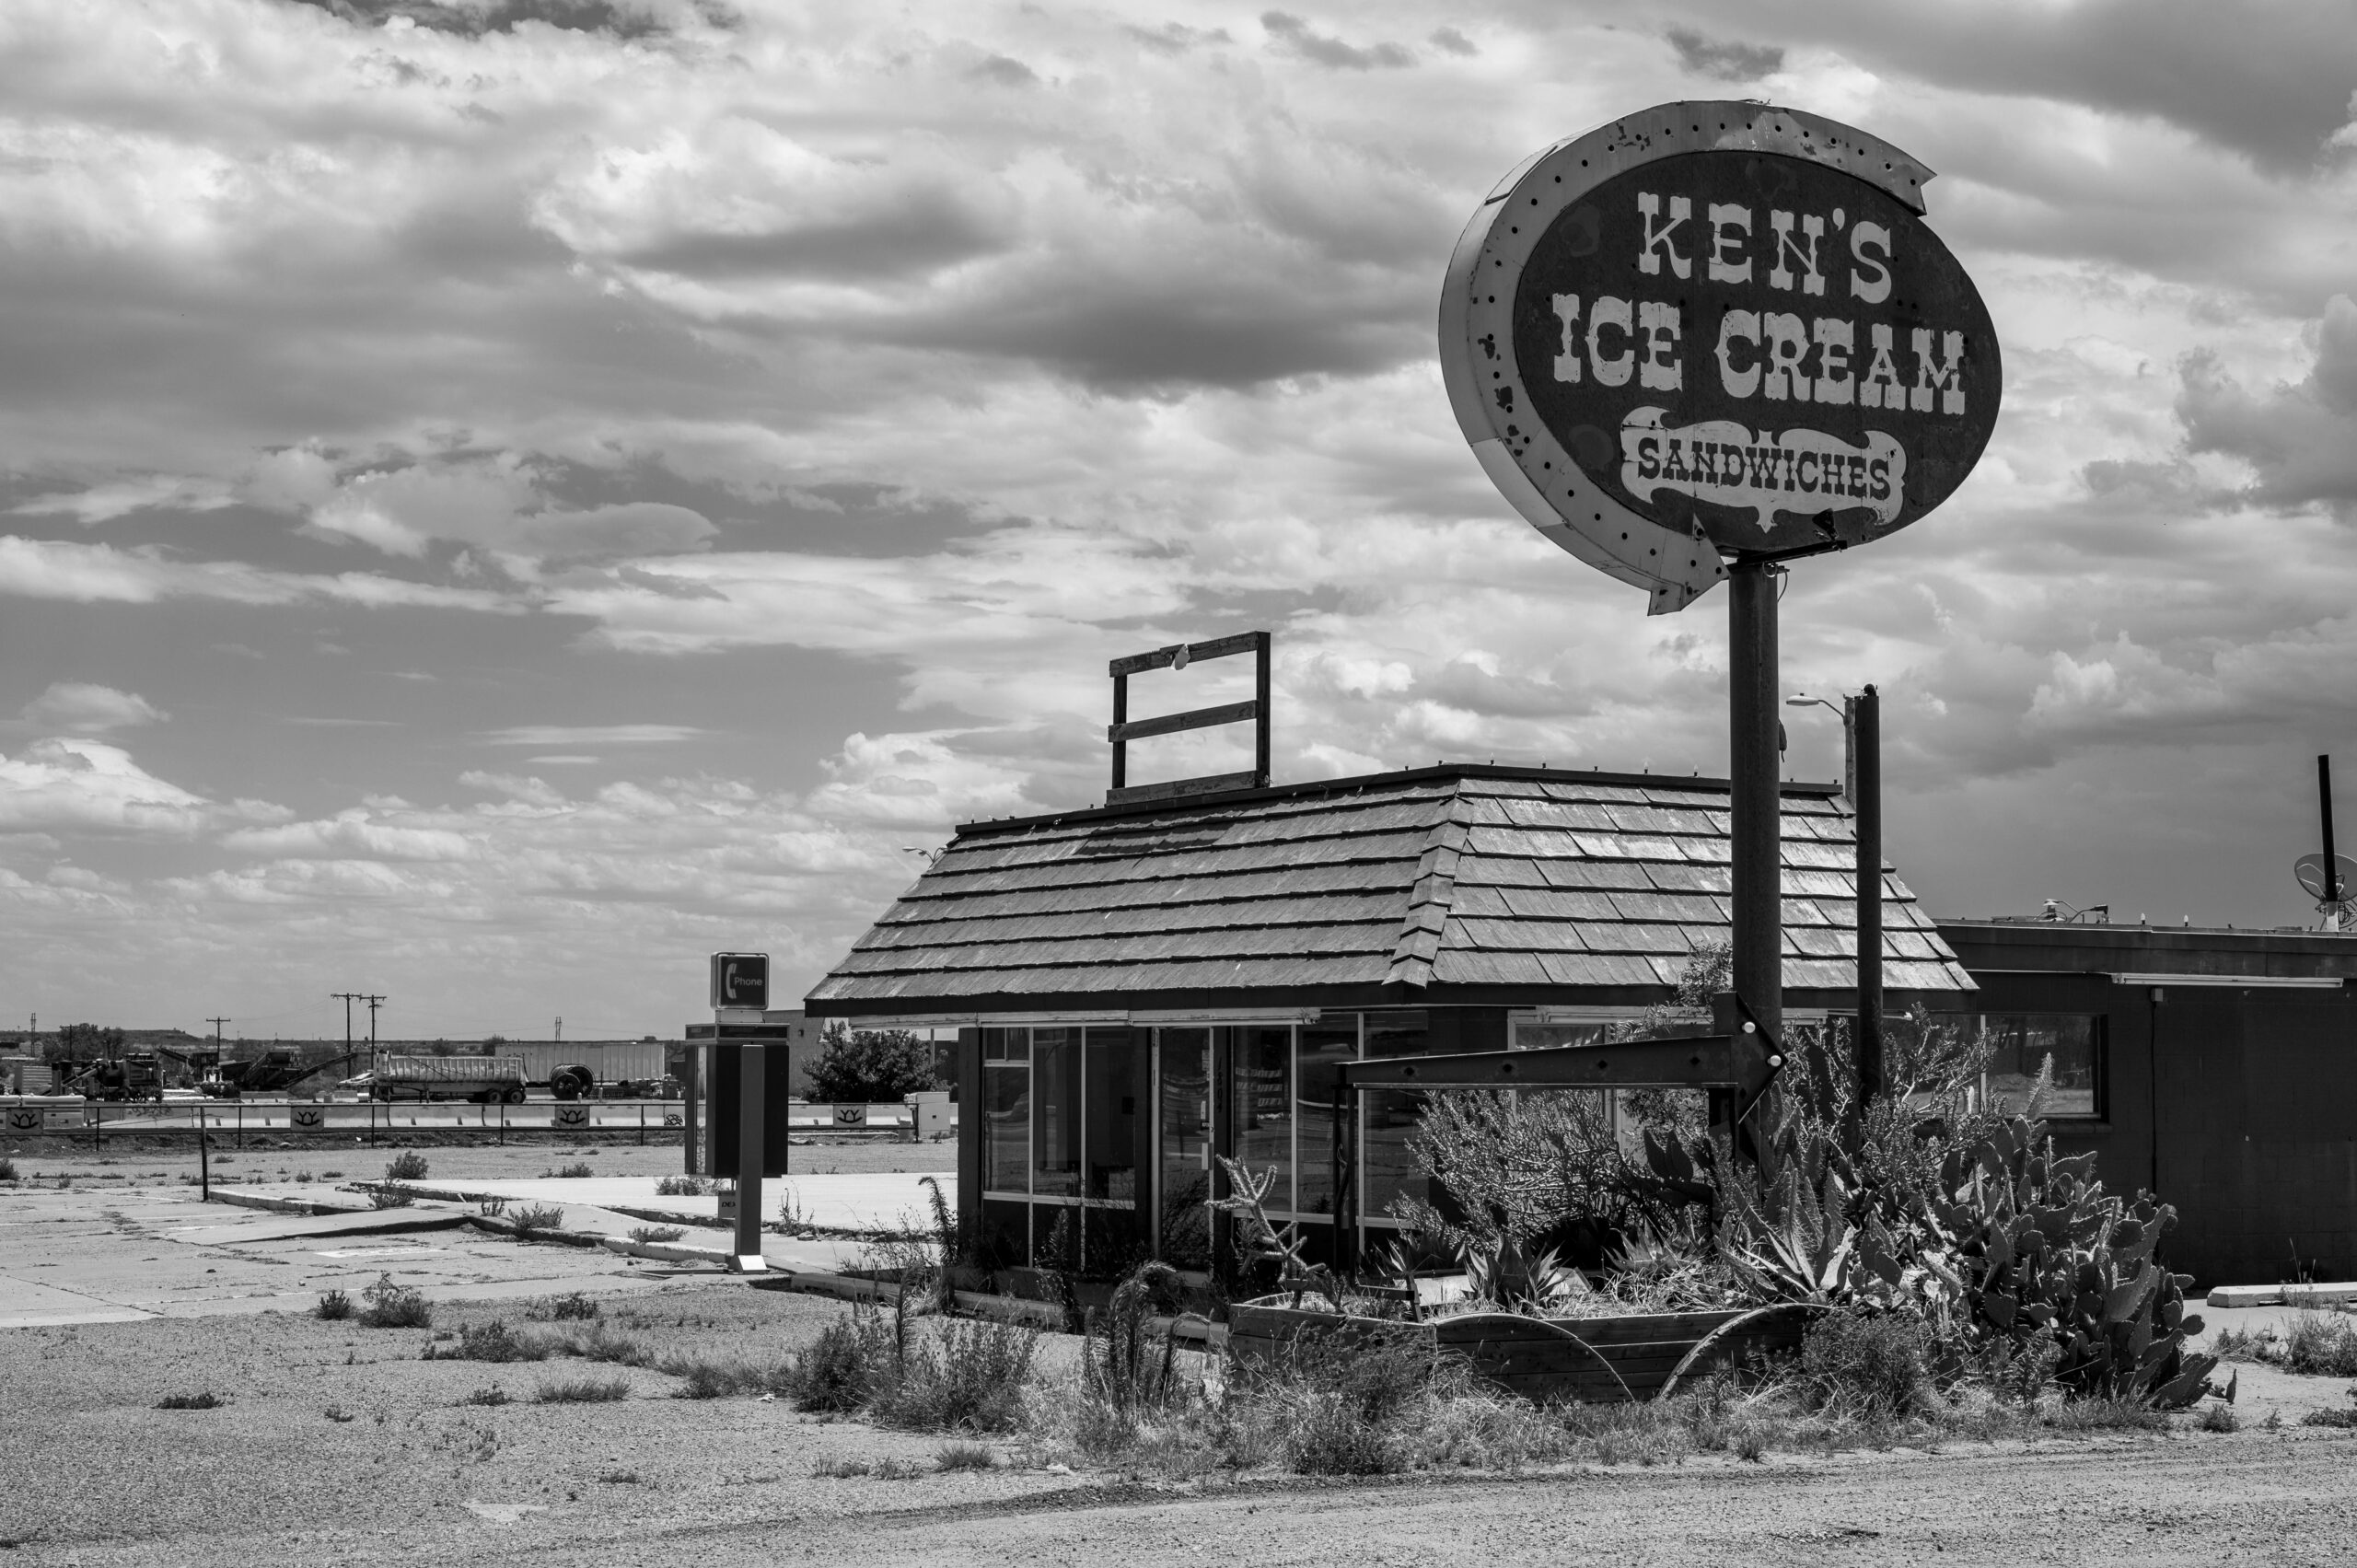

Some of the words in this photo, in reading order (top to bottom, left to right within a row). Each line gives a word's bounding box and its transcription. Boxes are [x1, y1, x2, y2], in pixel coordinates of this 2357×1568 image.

[1637, 192, 1893, 304] KEN'S
[1551, 293, 1684, 393] ICE
[1713, 308, 1967, 416] CREAM
[1636, 436, 1893, 500] SANDWICHES
[734, 976, 763, 987] Phone
